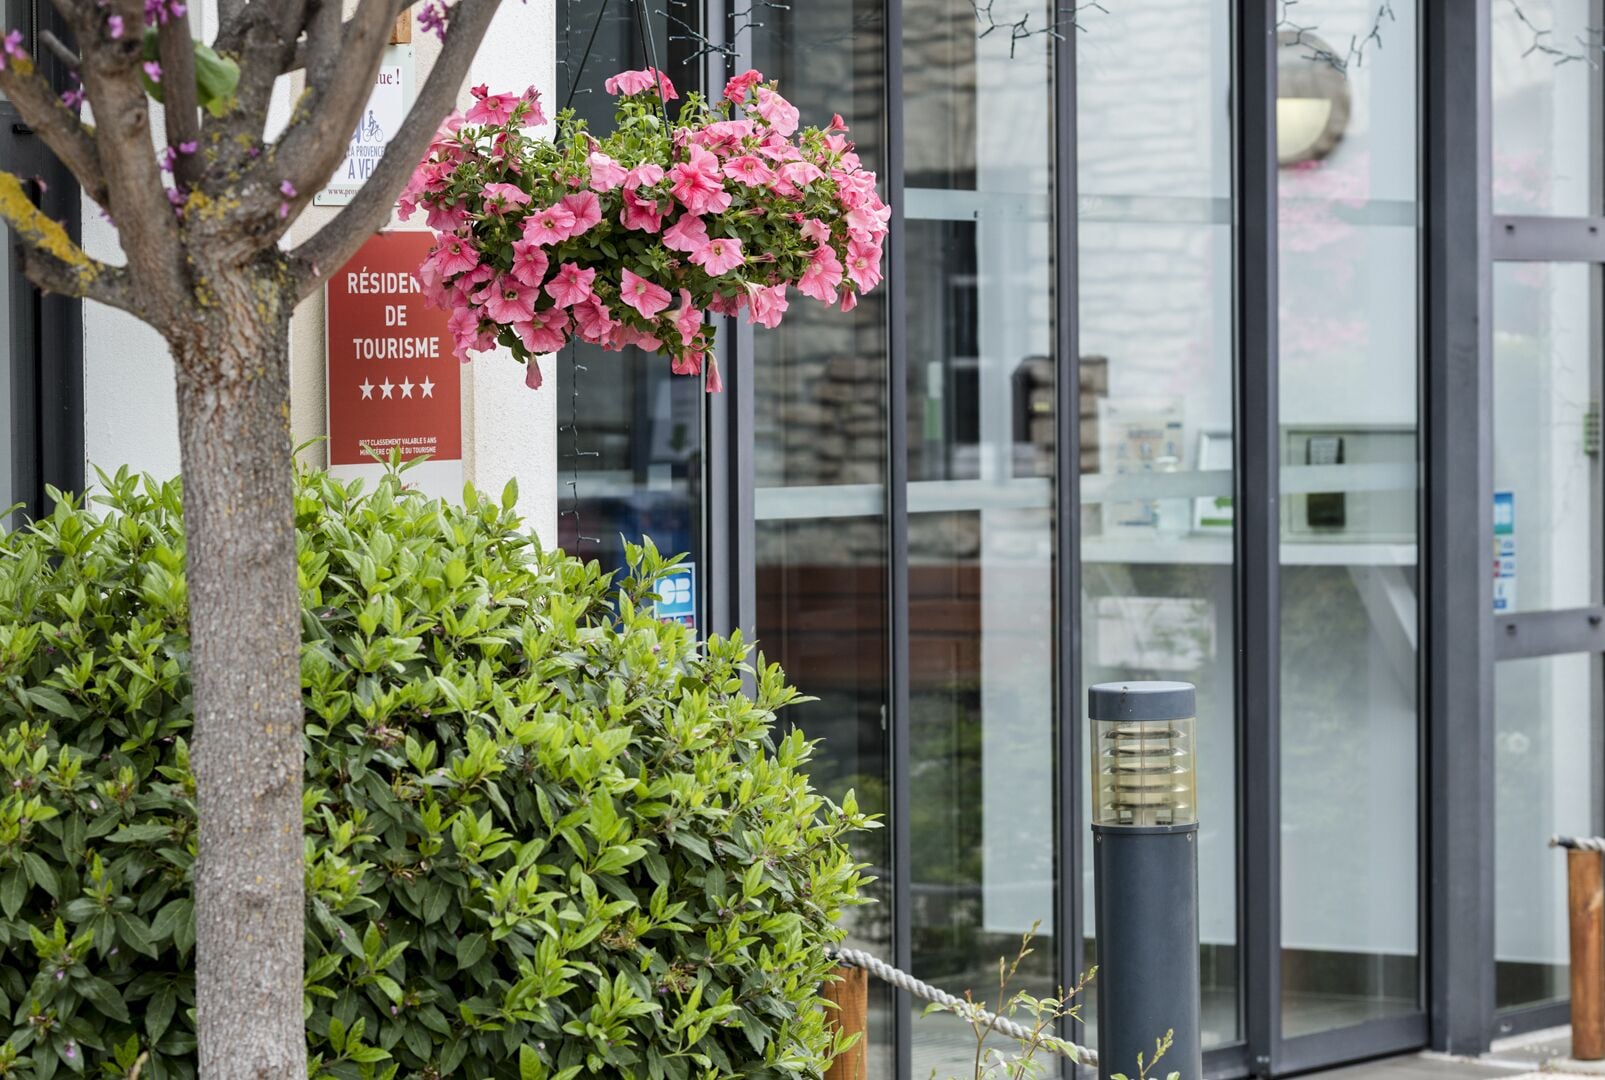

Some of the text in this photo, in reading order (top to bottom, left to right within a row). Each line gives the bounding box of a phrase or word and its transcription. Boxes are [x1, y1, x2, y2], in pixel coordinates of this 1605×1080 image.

[348, 266, 420, 294] RÉSIDEN
[385, 305, 407, 326] DE
[353, 337, 440, 359] TOURISME
[370, 438, 401, 446] CLASSEMENT
[402, 437, 422, 445] VALABLE
[427, 436, 437, 444] ANS
[413, 446, 436, 454] TOURISME
